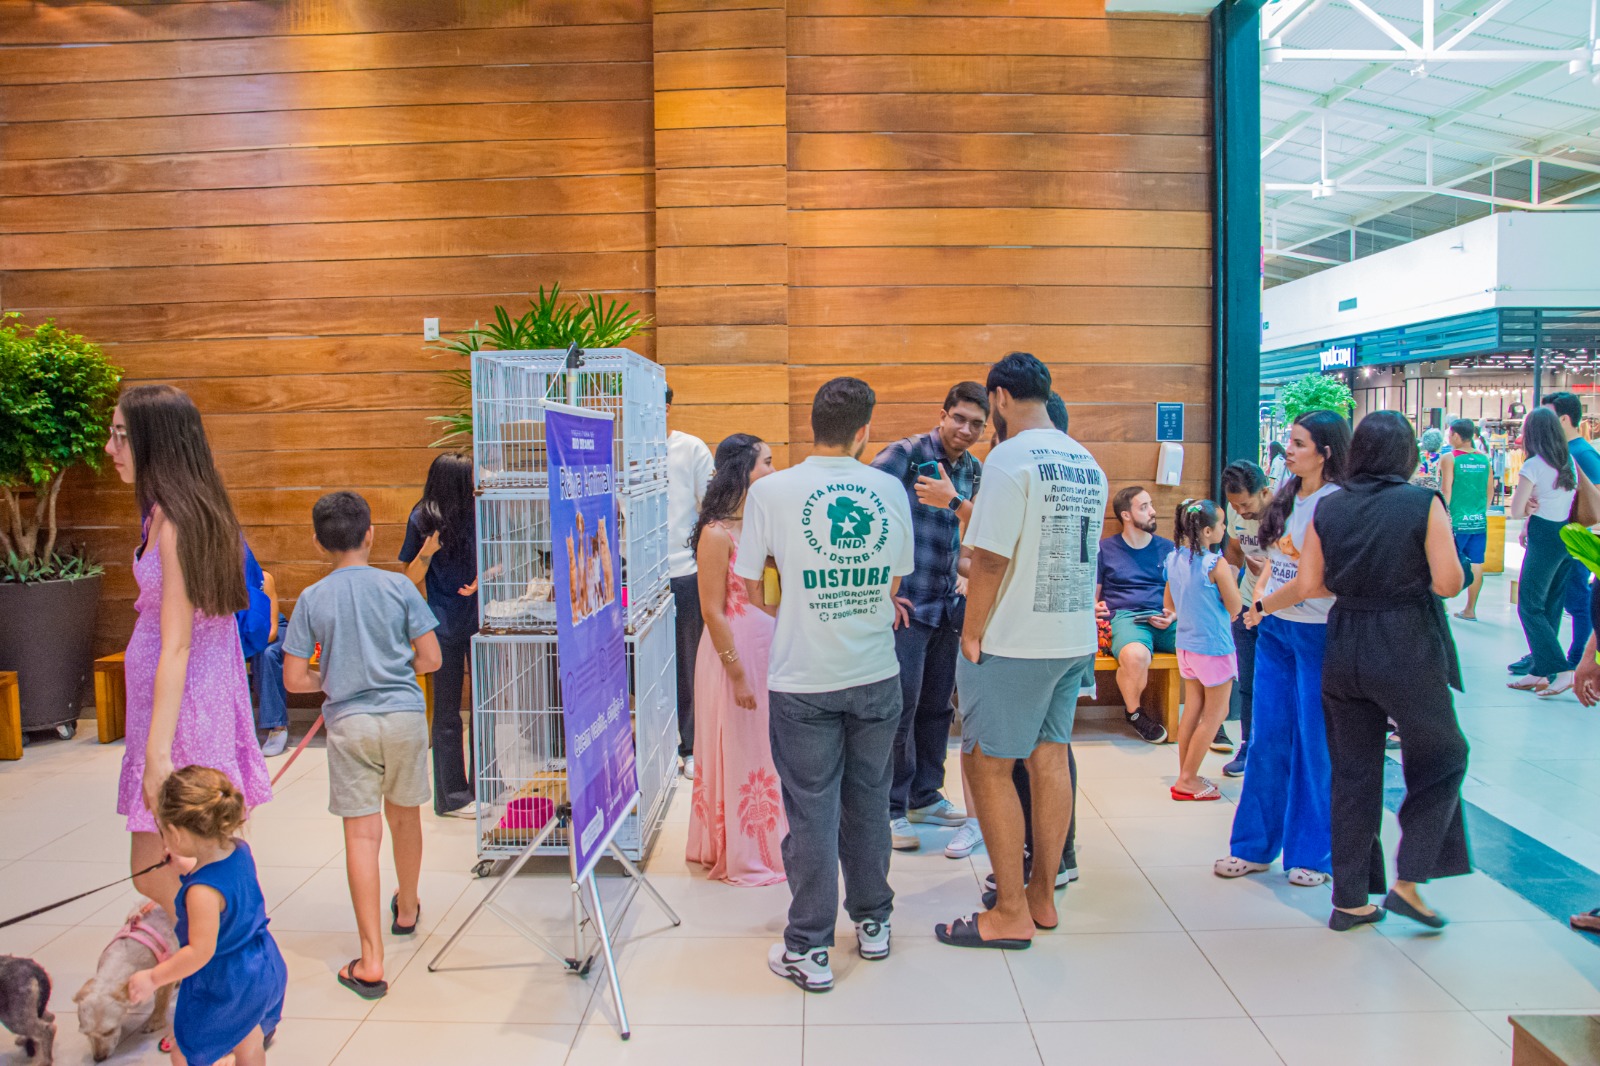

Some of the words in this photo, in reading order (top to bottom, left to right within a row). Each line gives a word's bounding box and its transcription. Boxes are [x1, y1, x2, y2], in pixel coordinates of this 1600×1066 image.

[1037, 463, 1059, 481] FIVE
[826, 483, 866, 494] KNOW
[869, 491, 886, 514] THE
[1044, 493, 1059, 503] Vito
[801, 489, 825, 526] GOTTA
[1462, 513, 1484, 521] ACRE
[803, 530, 822, 554] YOU
[873, 518, 889, 552] NAME
[829, 552, 870, 565] DSTRB
[809, 600, 843, 610] STREET
